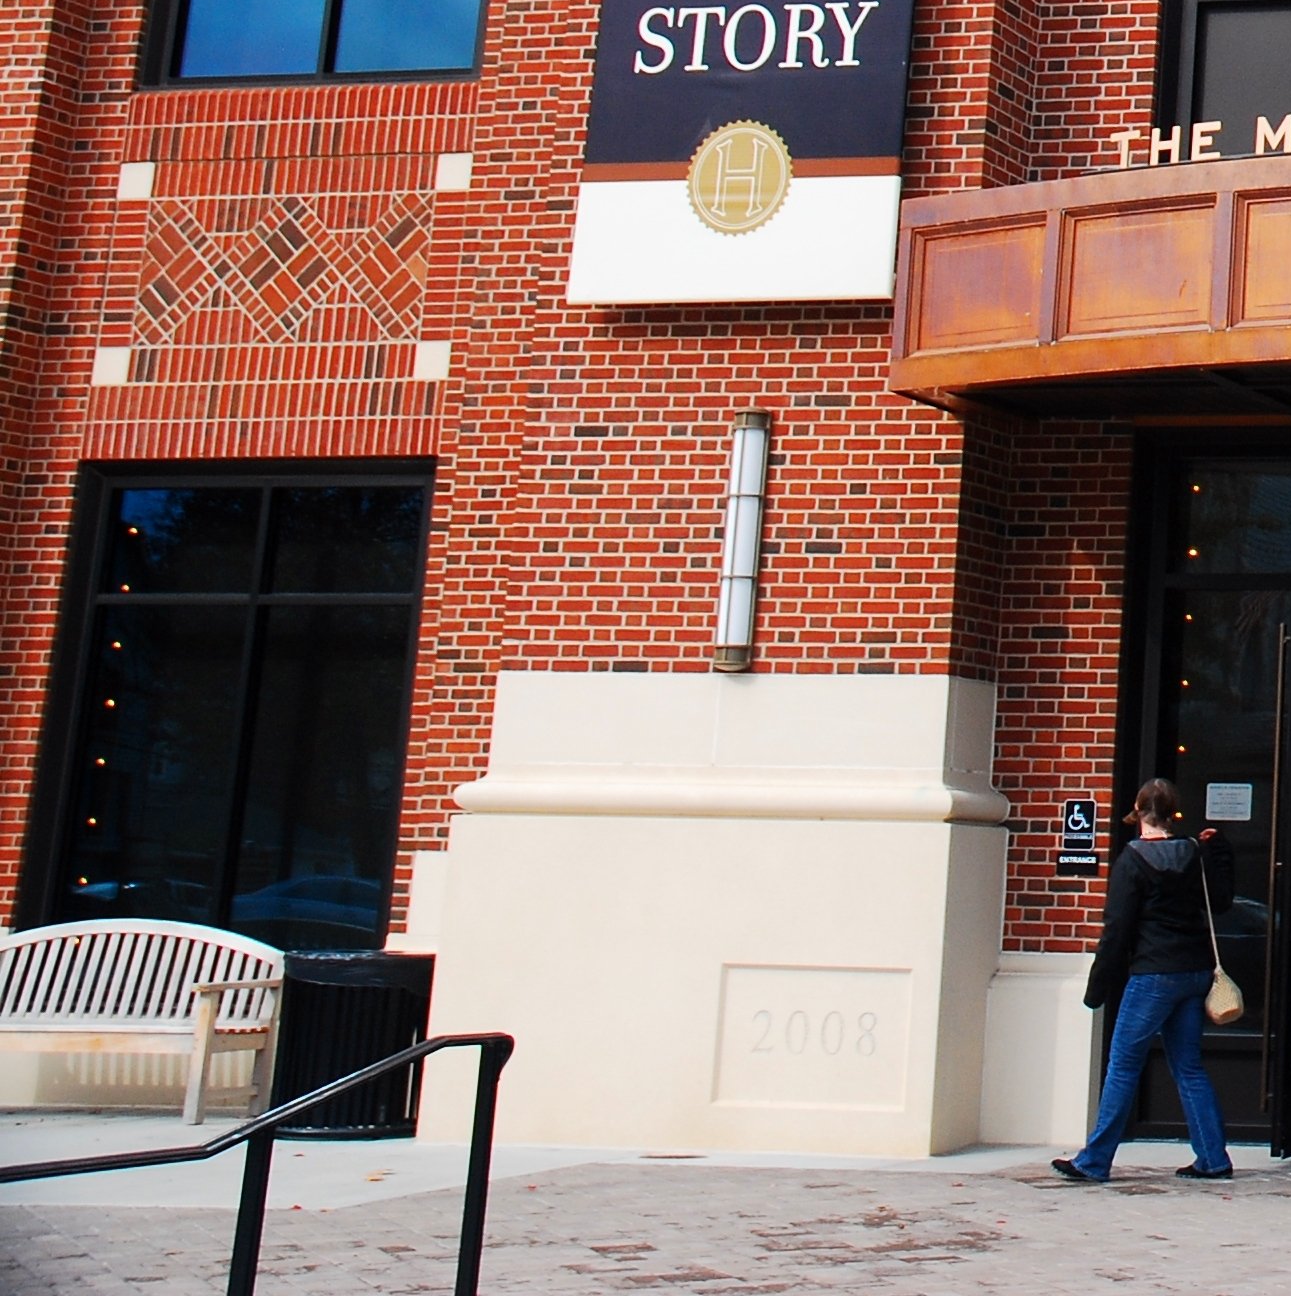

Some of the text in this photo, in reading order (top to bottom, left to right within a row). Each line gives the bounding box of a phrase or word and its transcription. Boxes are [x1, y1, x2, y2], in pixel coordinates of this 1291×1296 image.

[633, 1, 880, 74] STORY
[1110, 120, 1223, 169] THE
[751, 1009, 878, 1057] 2008
